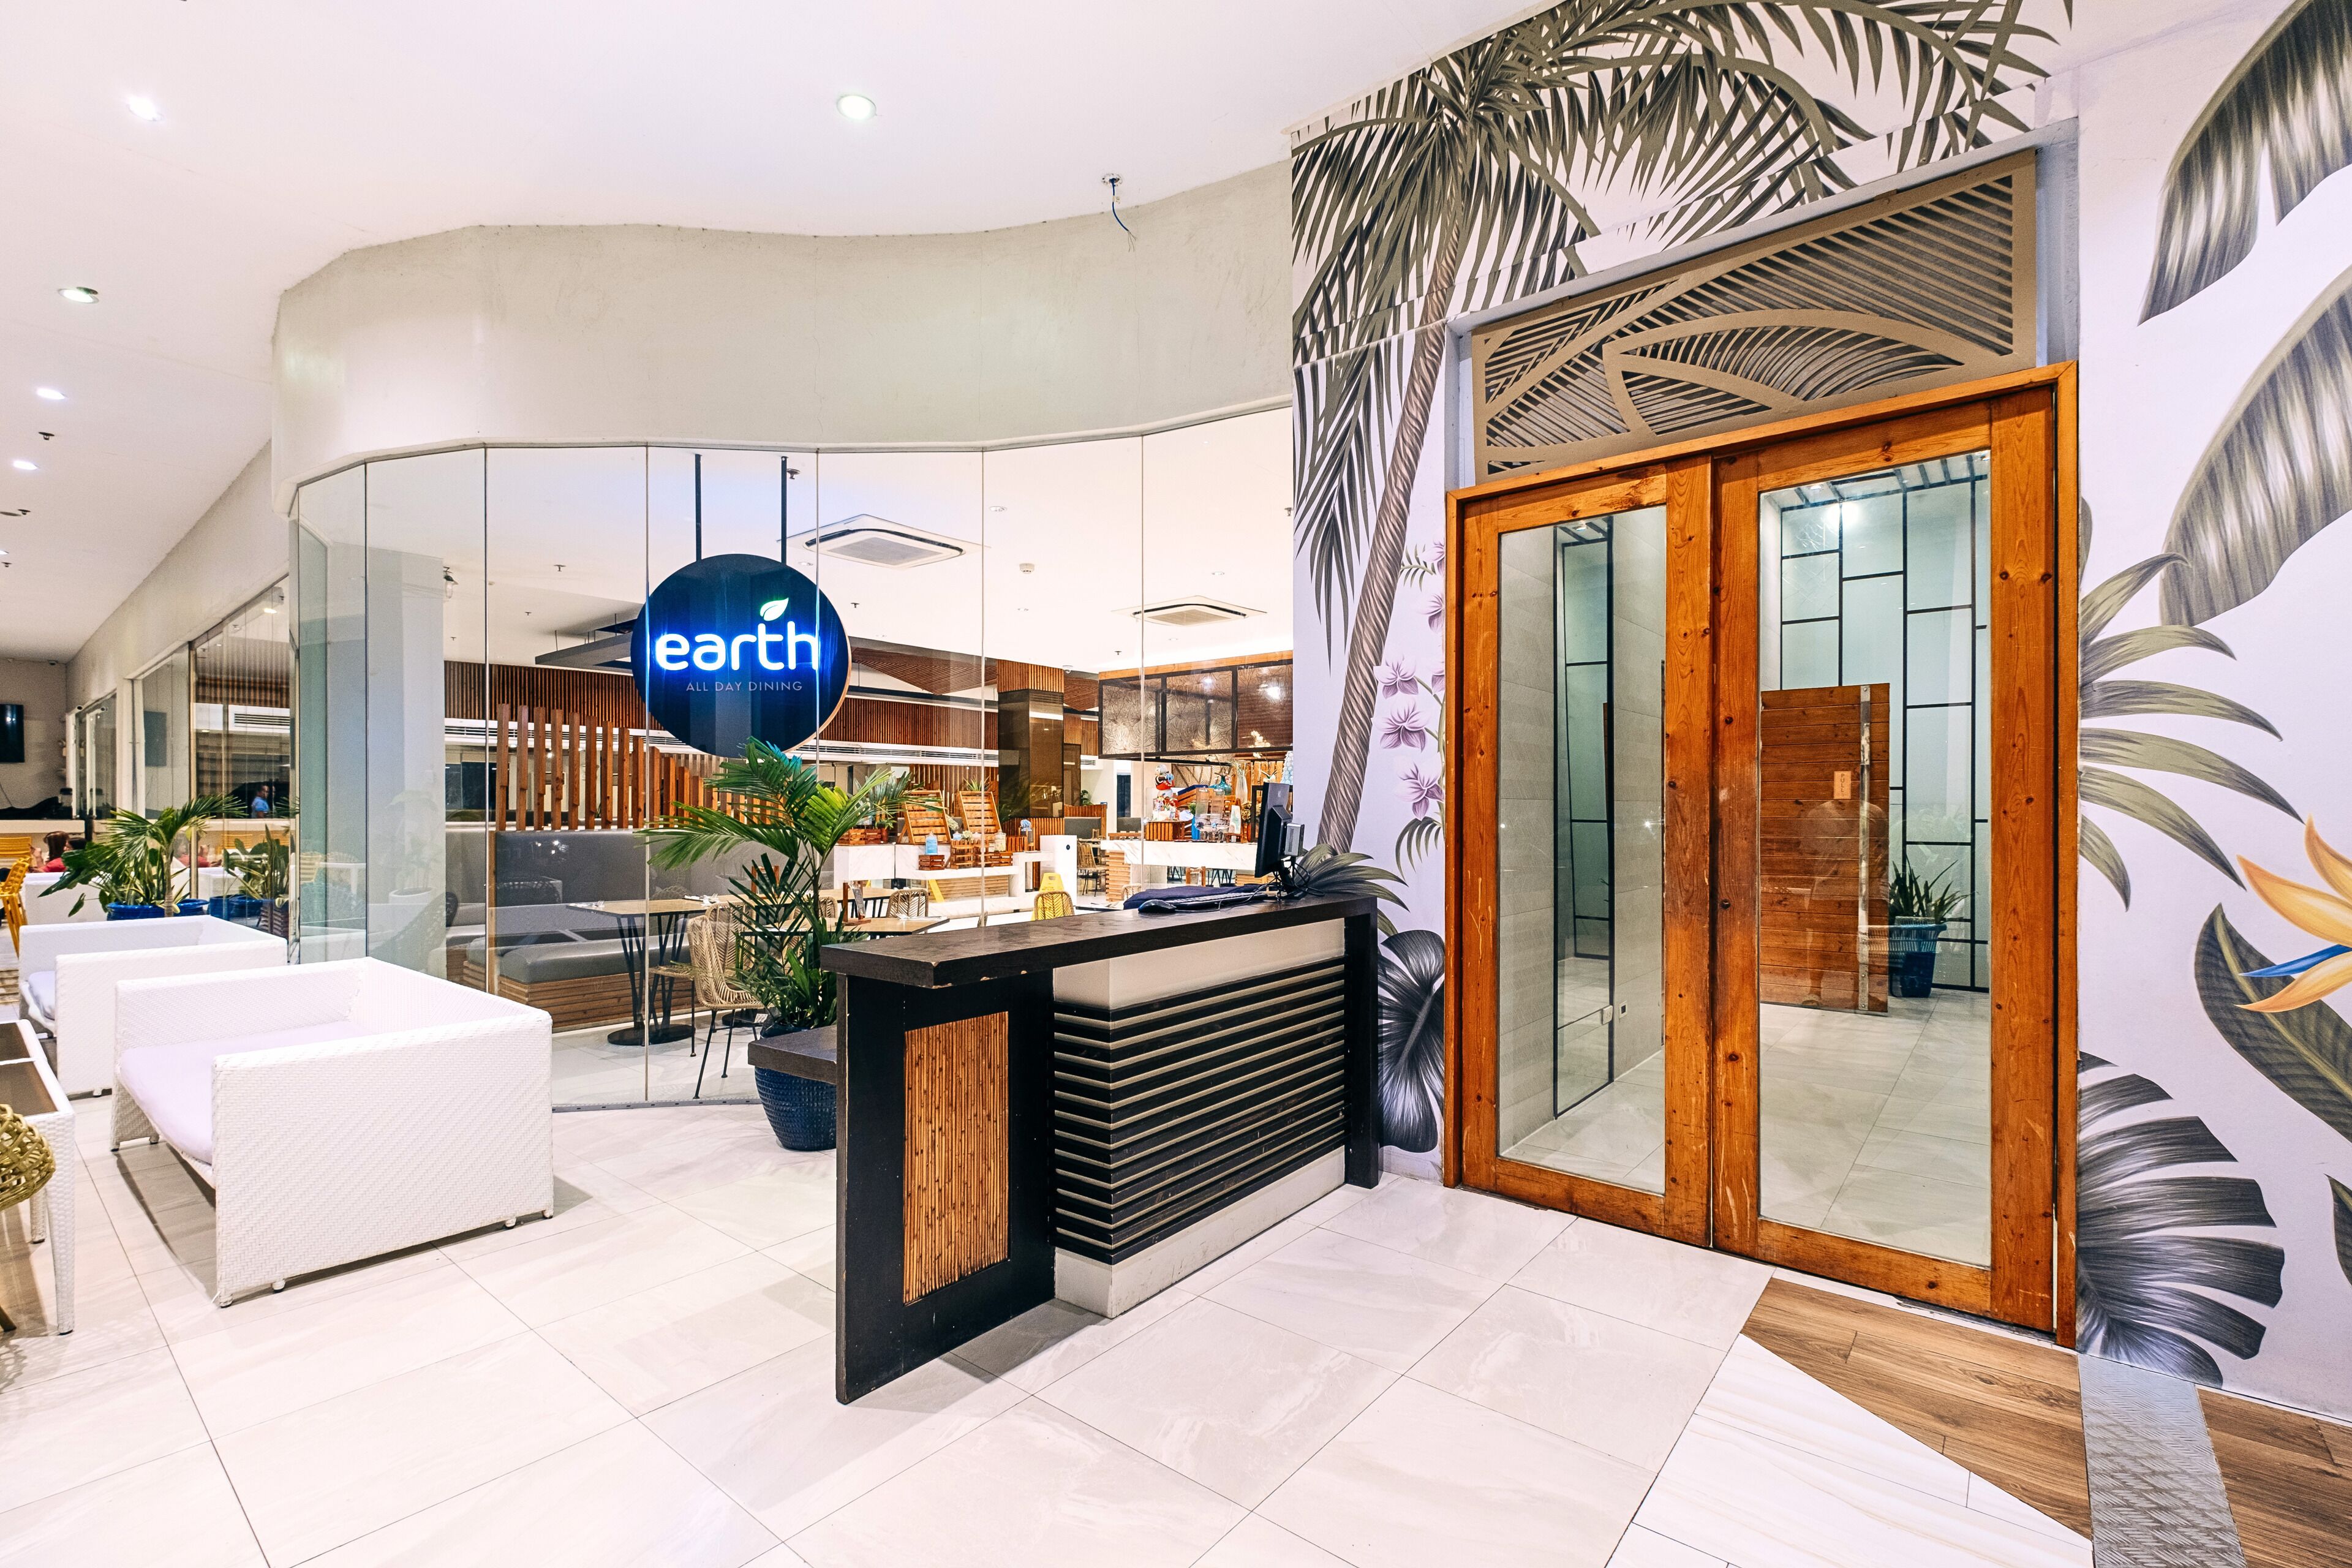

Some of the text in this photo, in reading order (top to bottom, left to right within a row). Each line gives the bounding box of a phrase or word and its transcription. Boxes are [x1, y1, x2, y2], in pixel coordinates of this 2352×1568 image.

[655, 620, 820, 671] earth
[686, 681, 802, 692] ALL DAY DINING
